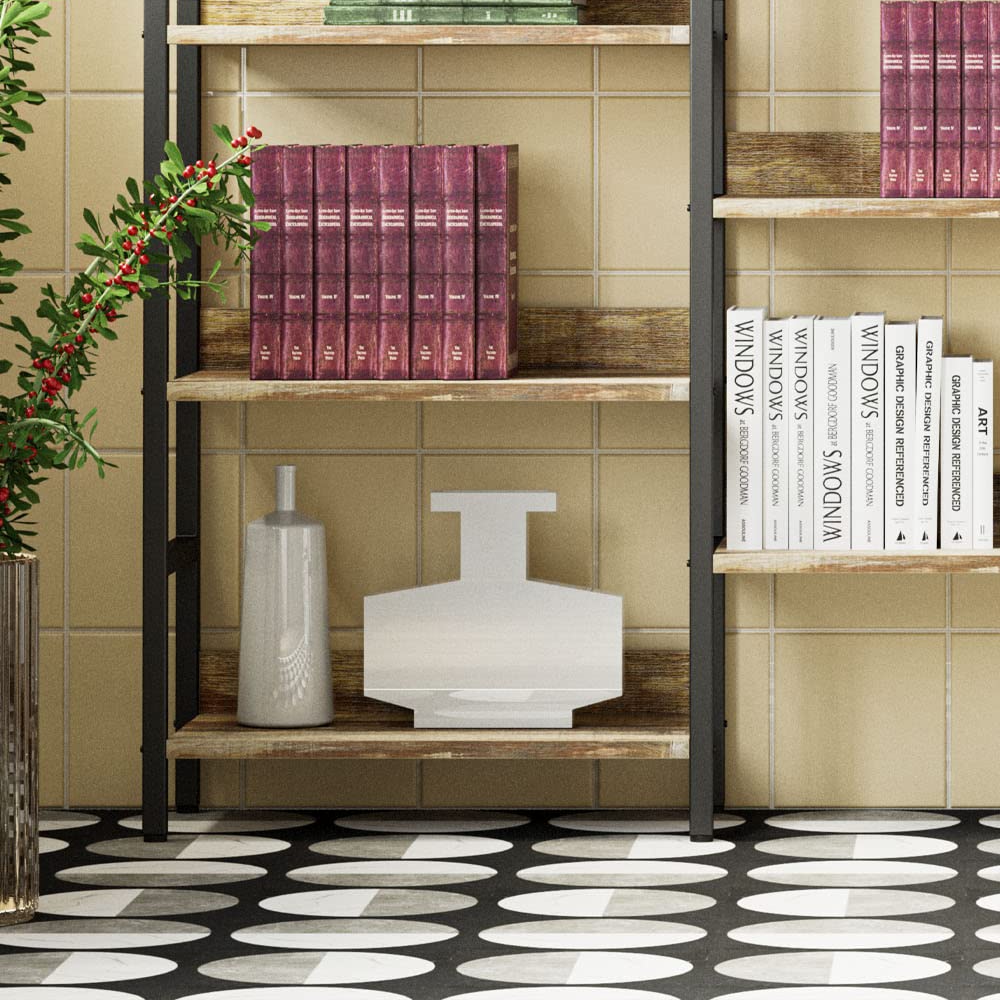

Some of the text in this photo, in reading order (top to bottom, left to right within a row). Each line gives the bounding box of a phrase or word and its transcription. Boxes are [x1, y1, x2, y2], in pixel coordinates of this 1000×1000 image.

[735, 320, 754, 415] WINDOWS
[769, 330, 782, 420] WINDOWS
[795, 328, 807, 420] WINDOWS
[828, 364, 837, 401] GOODMAN
[861, 325, 878, 418] WINDOWS
[925, 341, 933, 388] GRAPHIC
[740, 427, 748, 464] BERGDORF
[828, 403, 837, 439] BERGDORF
[896, 346, 904, 506] GRAPHIC DESIGN REFERENCED
[952, 375, 960, 511] GRAPHIC DESIGN REFERENCED
[978, 408, 987, 435] ART
[740, 466, 748, 505] GOODMAN
[823, 450, 842, 542] WINDOWS
